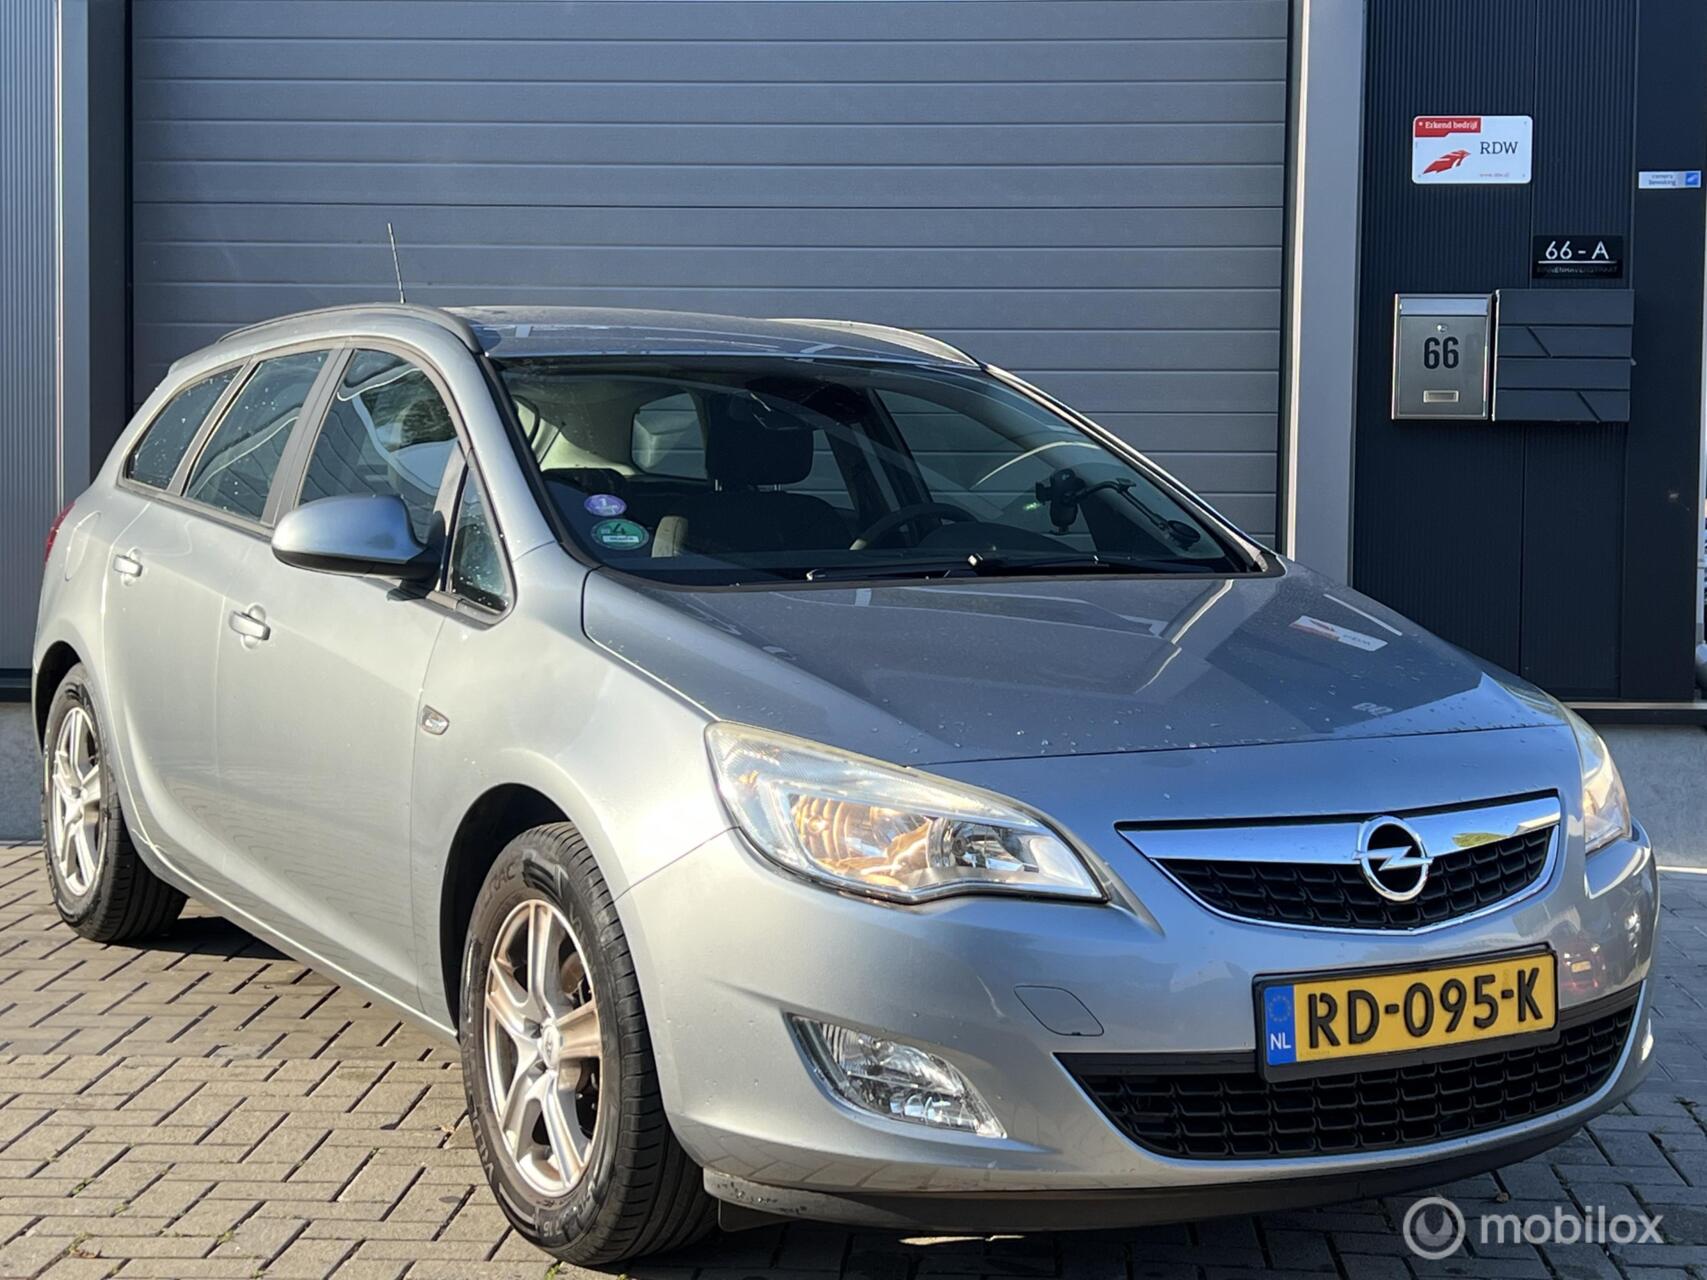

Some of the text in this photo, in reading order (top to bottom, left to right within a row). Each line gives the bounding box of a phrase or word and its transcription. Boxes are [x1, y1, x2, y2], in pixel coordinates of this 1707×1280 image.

[1425, 120, 1452, 129] Erkend
[1480, 141, 1519, 155] RDW
[1423, 336, 1460, 370] 66
[1307, 967, 1544, 1050] RD-095-K
[1270, 1032, 1292, 1051] NL
